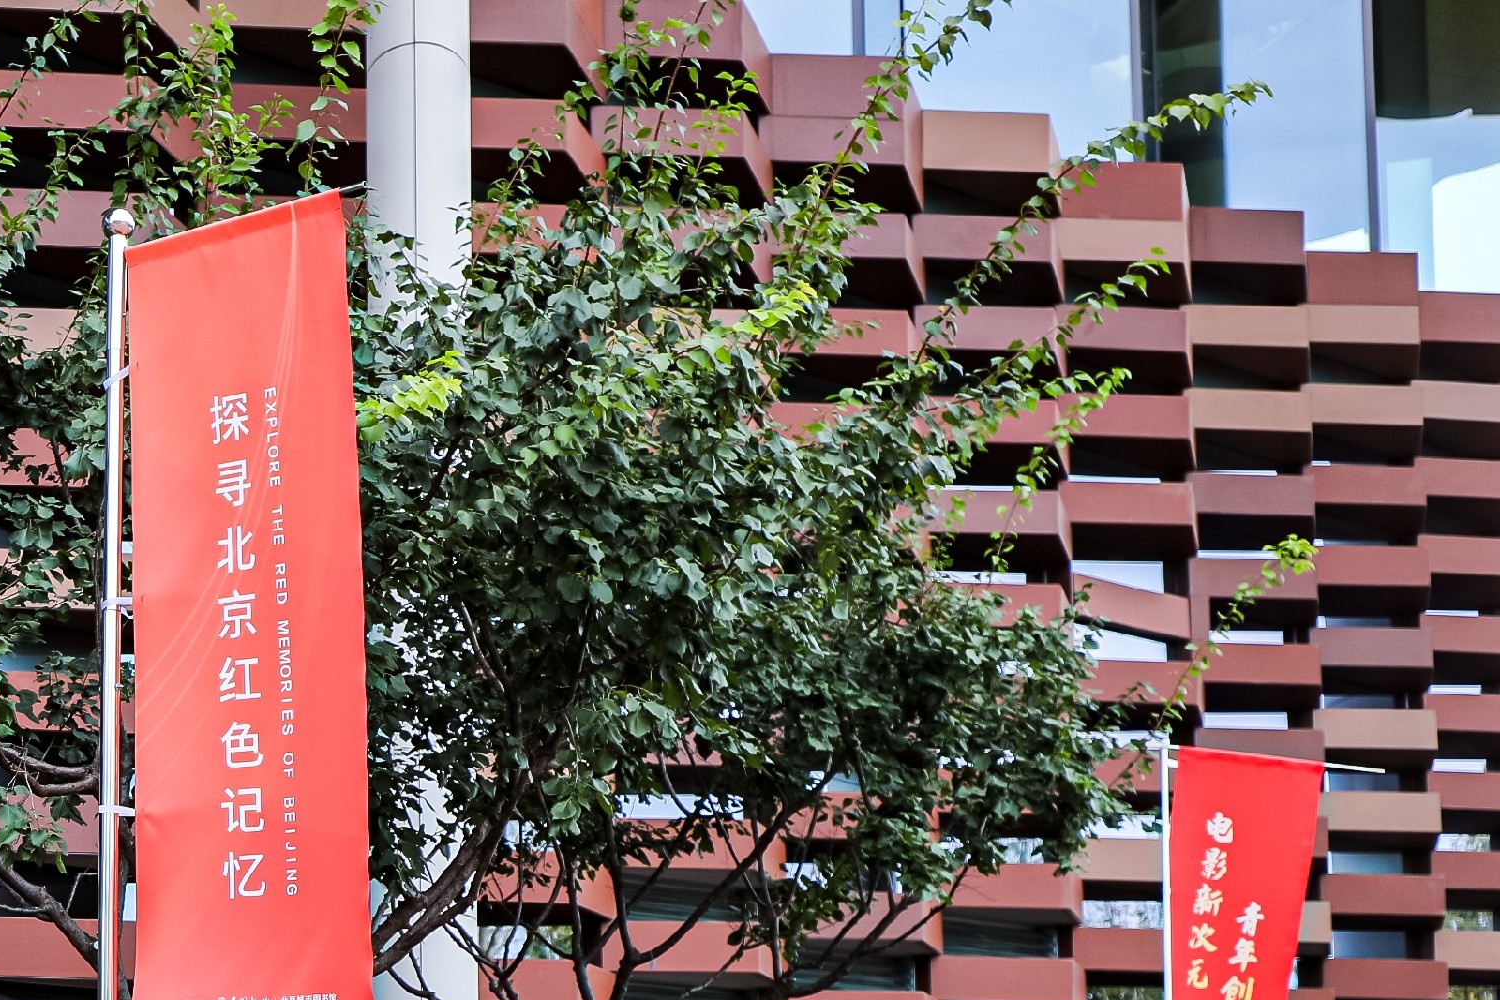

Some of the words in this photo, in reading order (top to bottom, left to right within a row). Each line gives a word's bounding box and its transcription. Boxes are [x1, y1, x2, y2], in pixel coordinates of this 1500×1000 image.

[263, 386, 282, 488] EXPLORE
[269, 504, 286, 547] THE
[274, 562, 289, 606] RED
[209, 392, 266, 900] 探寻北京红色记忆
[276, 619, 295, 736] MEMORIES
[282, 752, 295, 779] OF
[282, 796, 299, 897] BEIJING
[1186, 811, 1234, 990] 电影新次元
